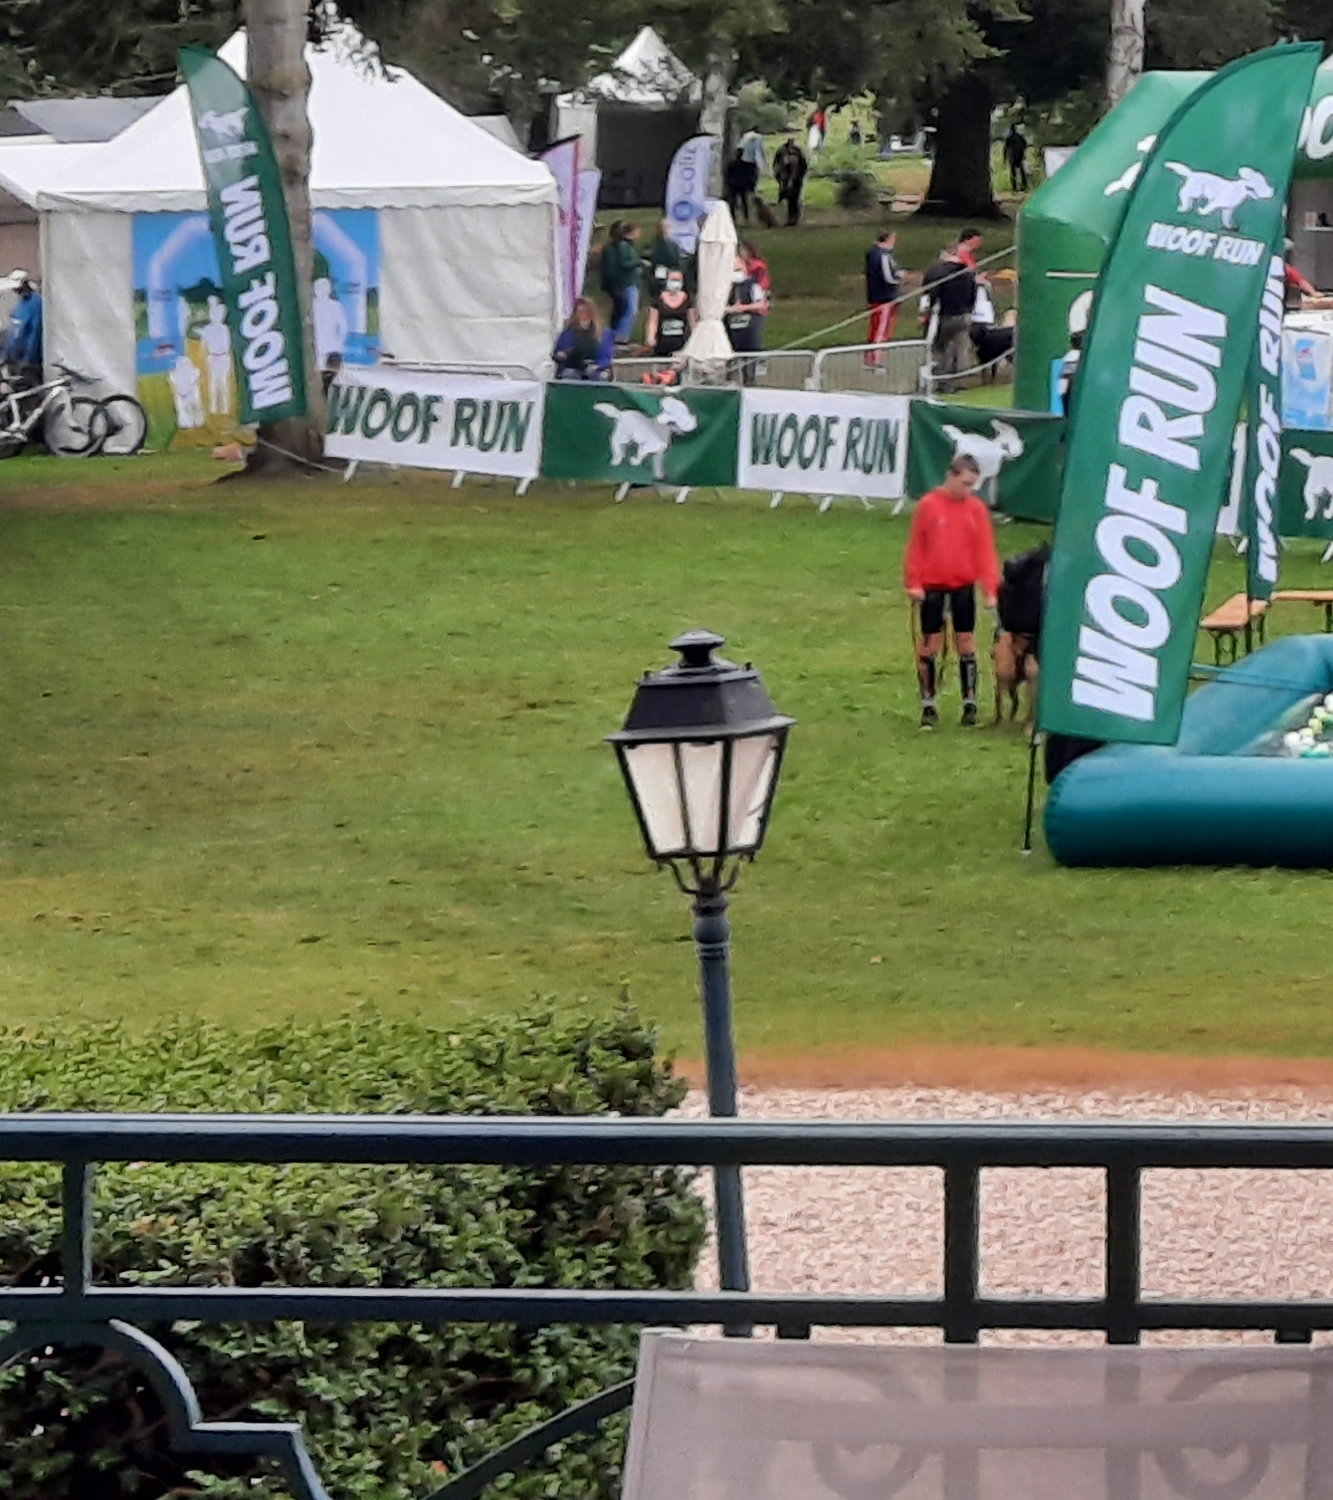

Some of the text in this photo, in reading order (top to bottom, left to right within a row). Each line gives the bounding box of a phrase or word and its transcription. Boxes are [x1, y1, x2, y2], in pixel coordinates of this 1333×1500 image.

[1146, 222, 1265, 266] WOOF RUN
[326, 384, 535, 452] WOOF RUN
[751, 412, 903, 475] WOOF RUN
[1071, 283, 1228, 722] WOOF RUN
[1255, 383, 1282, 583] WOOF
